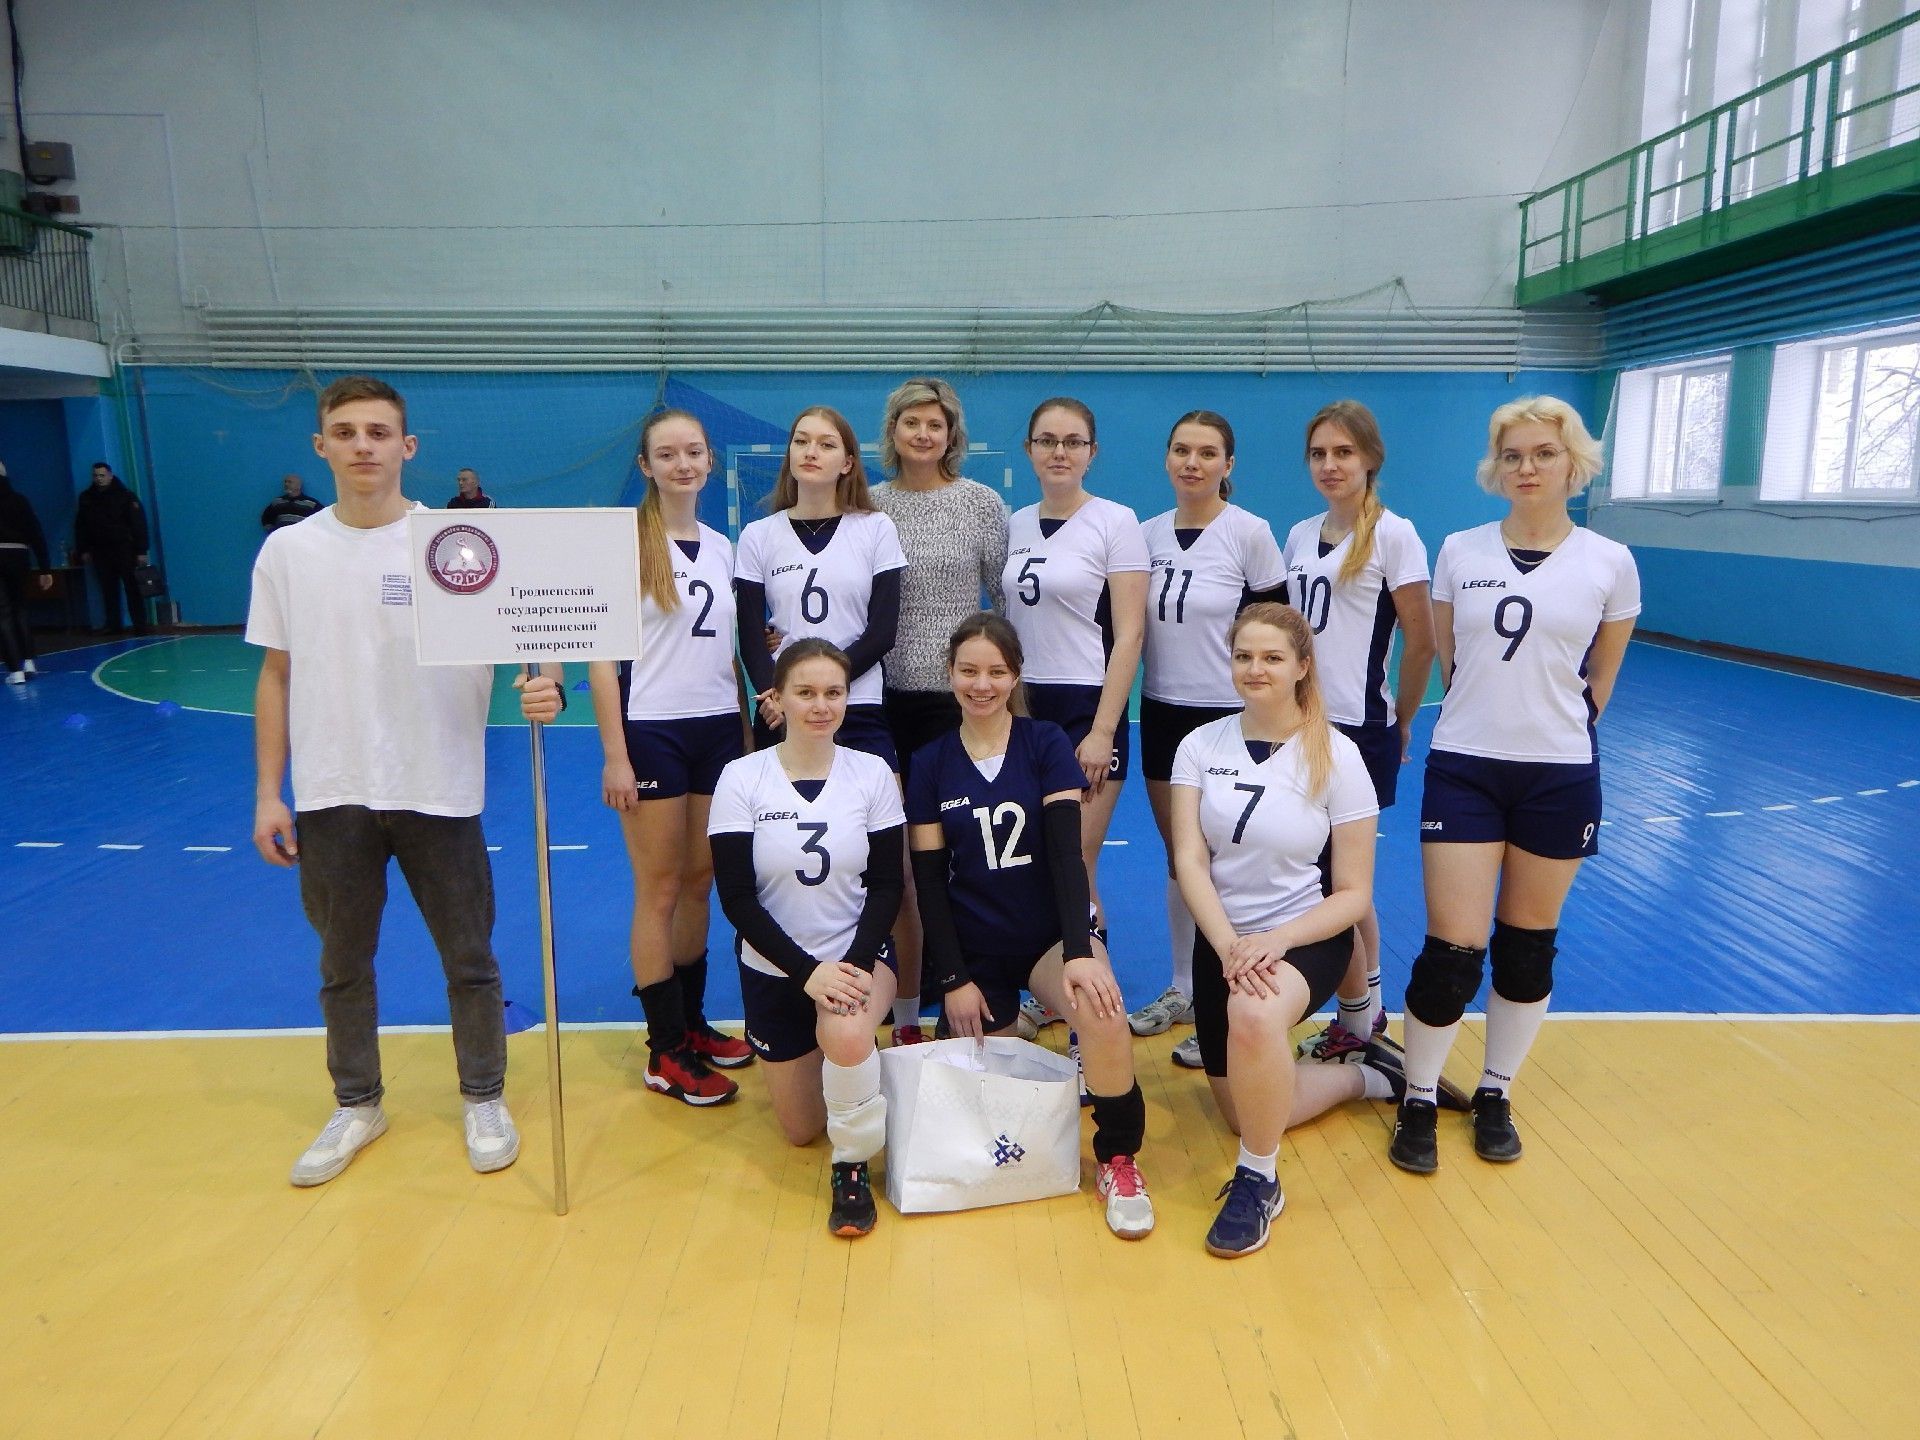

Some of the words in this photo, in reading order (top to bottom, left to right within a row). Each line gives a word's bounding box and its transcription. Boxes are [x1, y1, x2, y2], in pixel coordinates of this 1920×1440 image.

[771, 563, 803, 577] LEGEA
[1151, 560, 1172, 568] EGEA
[510, 585, 595, 600] Гродненский
[1017, 558, 1047, 607] 5
[1461, 579, 1507, 590] LEGEA
[801, 568, 829, 625] 6
[1158, 567, 1193, 623] 11
[1296, 573, 1332, 636] 10
[497, 602, 609, 618] государственный
[688, 579, 717, 638] 2
[511, 621, 598, 633] медицинский
[1493, 595, 1533, 662] 9
[515, 641, 595, 653] университет
[1206, 767, 1239, 777] EGEA
[940, 796, 971, 812] EGEA
[1231, 782, 1266, 845] 7
[758, 811, 799, 822] LEGEA
[972, 801, 1033, 870] 12
[1582, 822, 1595, 848] 9
[795, 822, 831, 887] 3
